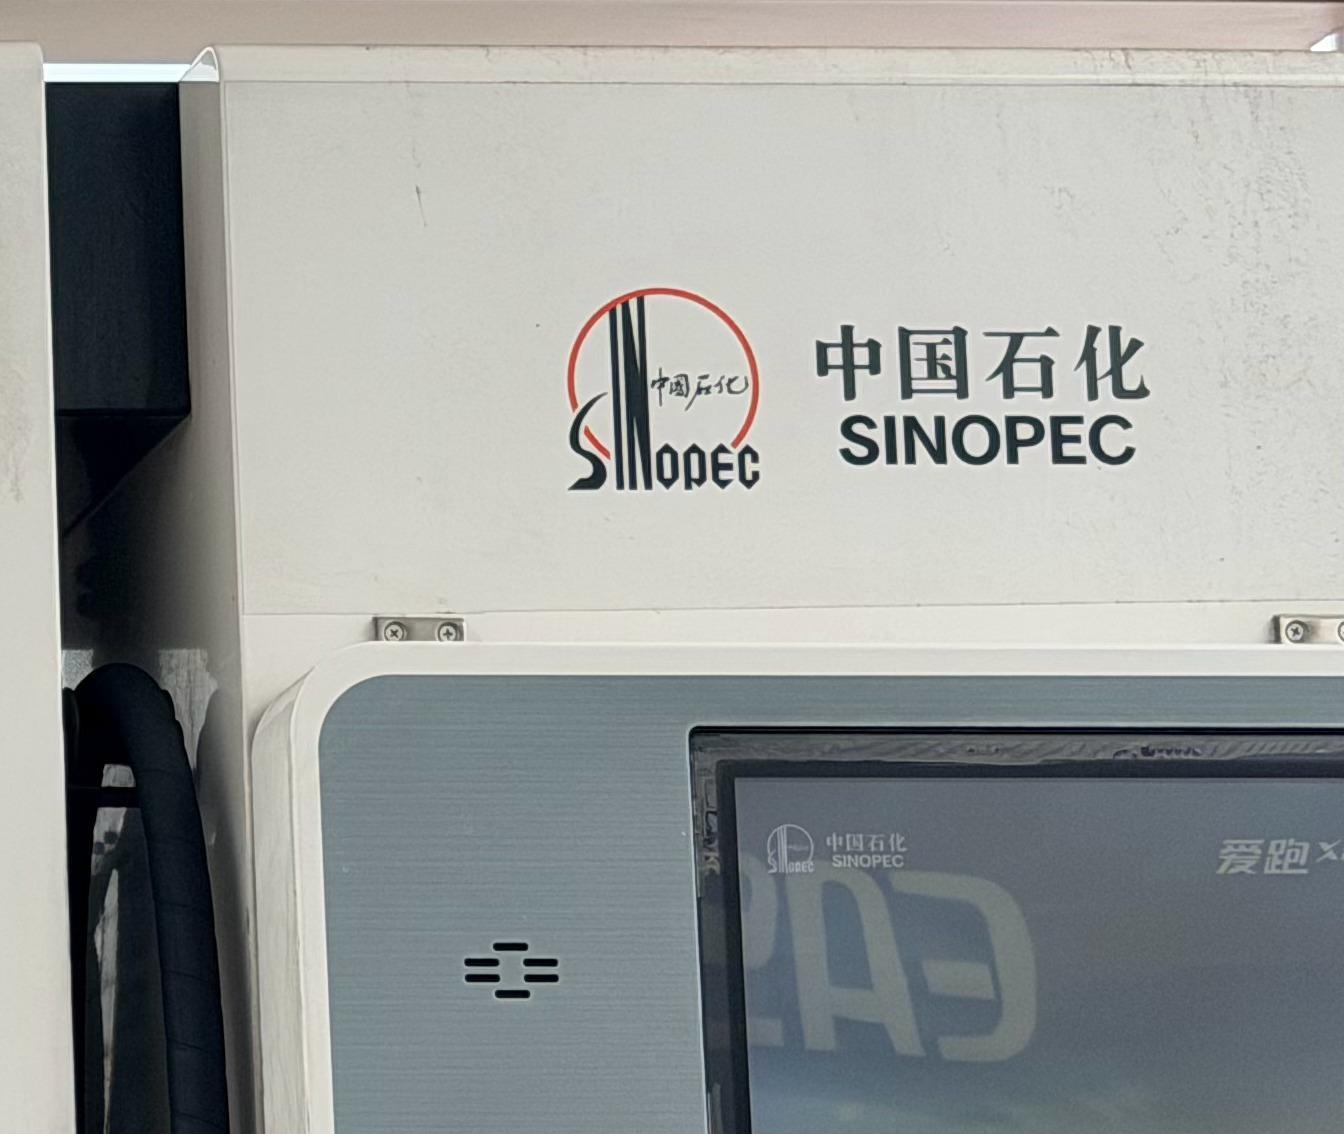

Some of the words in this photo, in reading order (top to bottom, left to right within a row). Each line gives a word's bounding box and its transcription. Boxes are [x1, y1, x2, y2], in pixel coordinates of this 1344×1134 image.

[815, 324, 1151, 402] 中国石化
[568, 295, 760, 491] SINOPEC
[839, 414, 1137, 466] SINOPEC
[825, 831, 909, 854] 中国石化
[831, 853, 905, 869] SINOPEC
[1216, 838, 1310, 875] 爱跑
